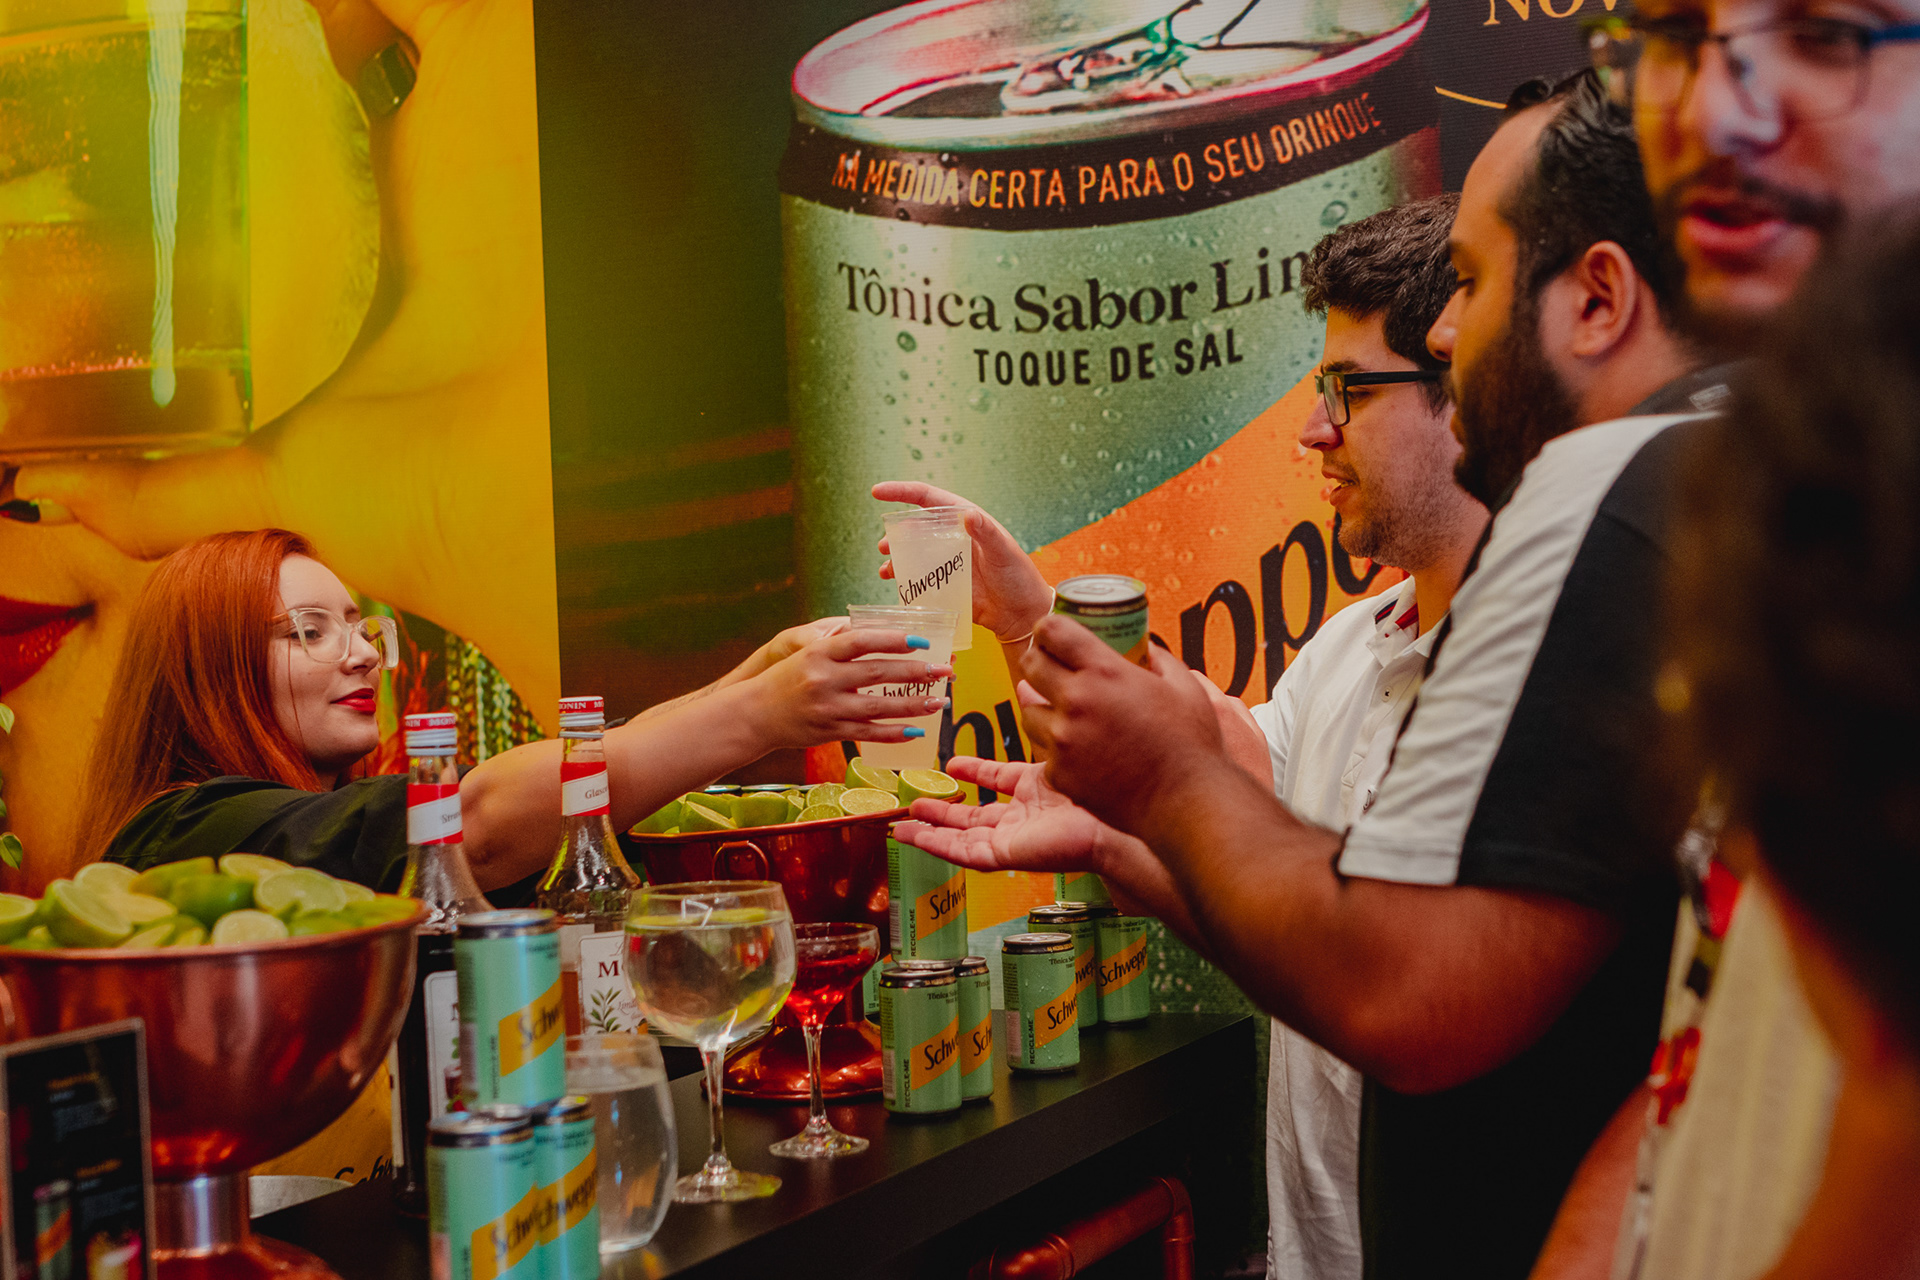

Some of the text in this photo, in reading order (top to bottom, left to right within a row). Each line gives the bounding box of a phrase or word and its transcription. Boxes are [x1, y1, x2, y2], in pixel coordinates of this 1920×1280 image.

[862, 159, 960, 206] MEDIDA
[969, 167, 1067, 209] CERTA
[1079, 157, 1165, 203] PARA
[1174, 152, 1195, 191] O
[1203, 132, 1265, 184] SEU
[837, 261, 1001, 332] Tônica
[1014, 278, 1199, 334] Sabor
[973, 327, 1244, 387] TOQUE DE SAL
[899, 550, 964, 607] Schweppes
[909, 908, 917, 957] RECICLE-ME
[1027, 1019, 1035, 1065] RECICLE-ME
